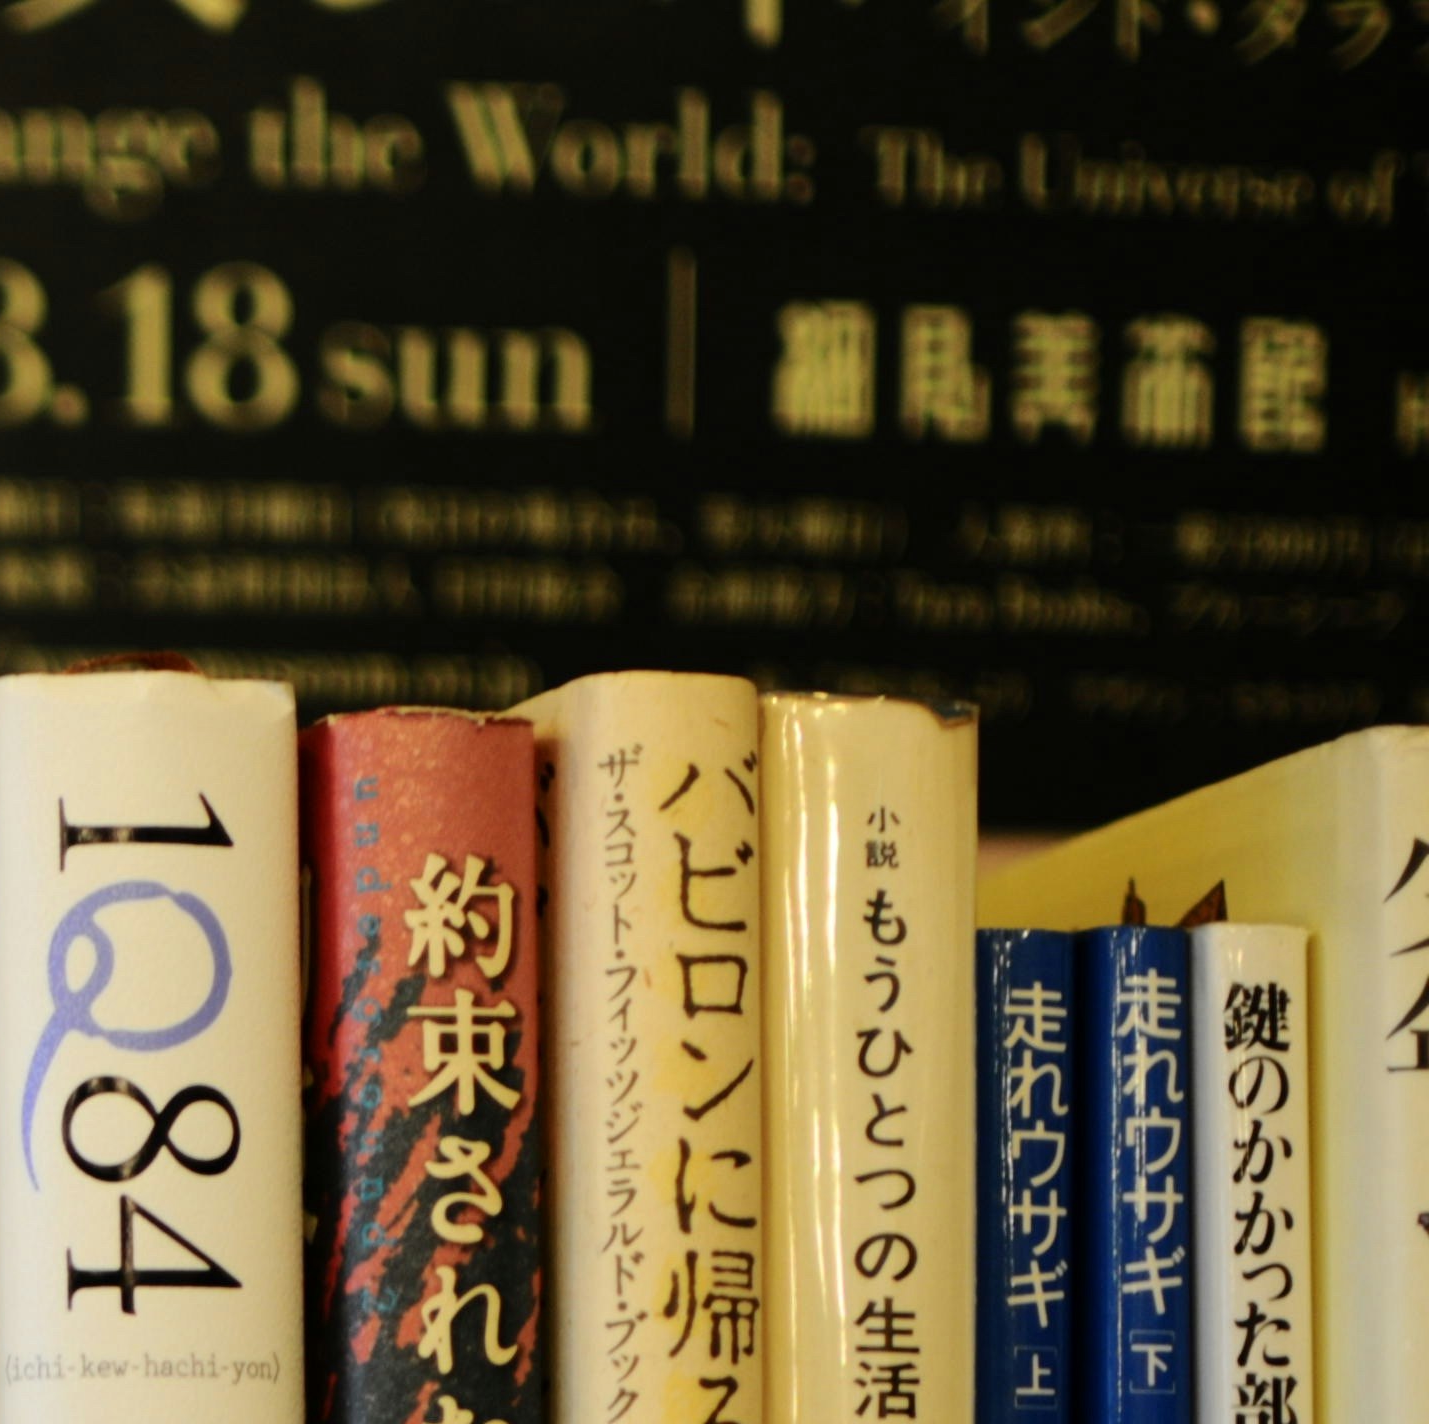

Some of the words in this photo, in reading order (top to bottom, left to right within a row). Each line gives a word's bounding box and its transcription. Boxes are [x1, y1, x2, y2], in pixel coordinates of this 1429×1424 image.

[250, 75, 425, 191] the
[20, 791, 242, 1315] 1Q84
[854, 889, 921, 1420] もうひとつの生活
[1003, 981, 1068, 1328] 走れウサギ
[1116, 968, 1185, 1315] 走れウサギ
